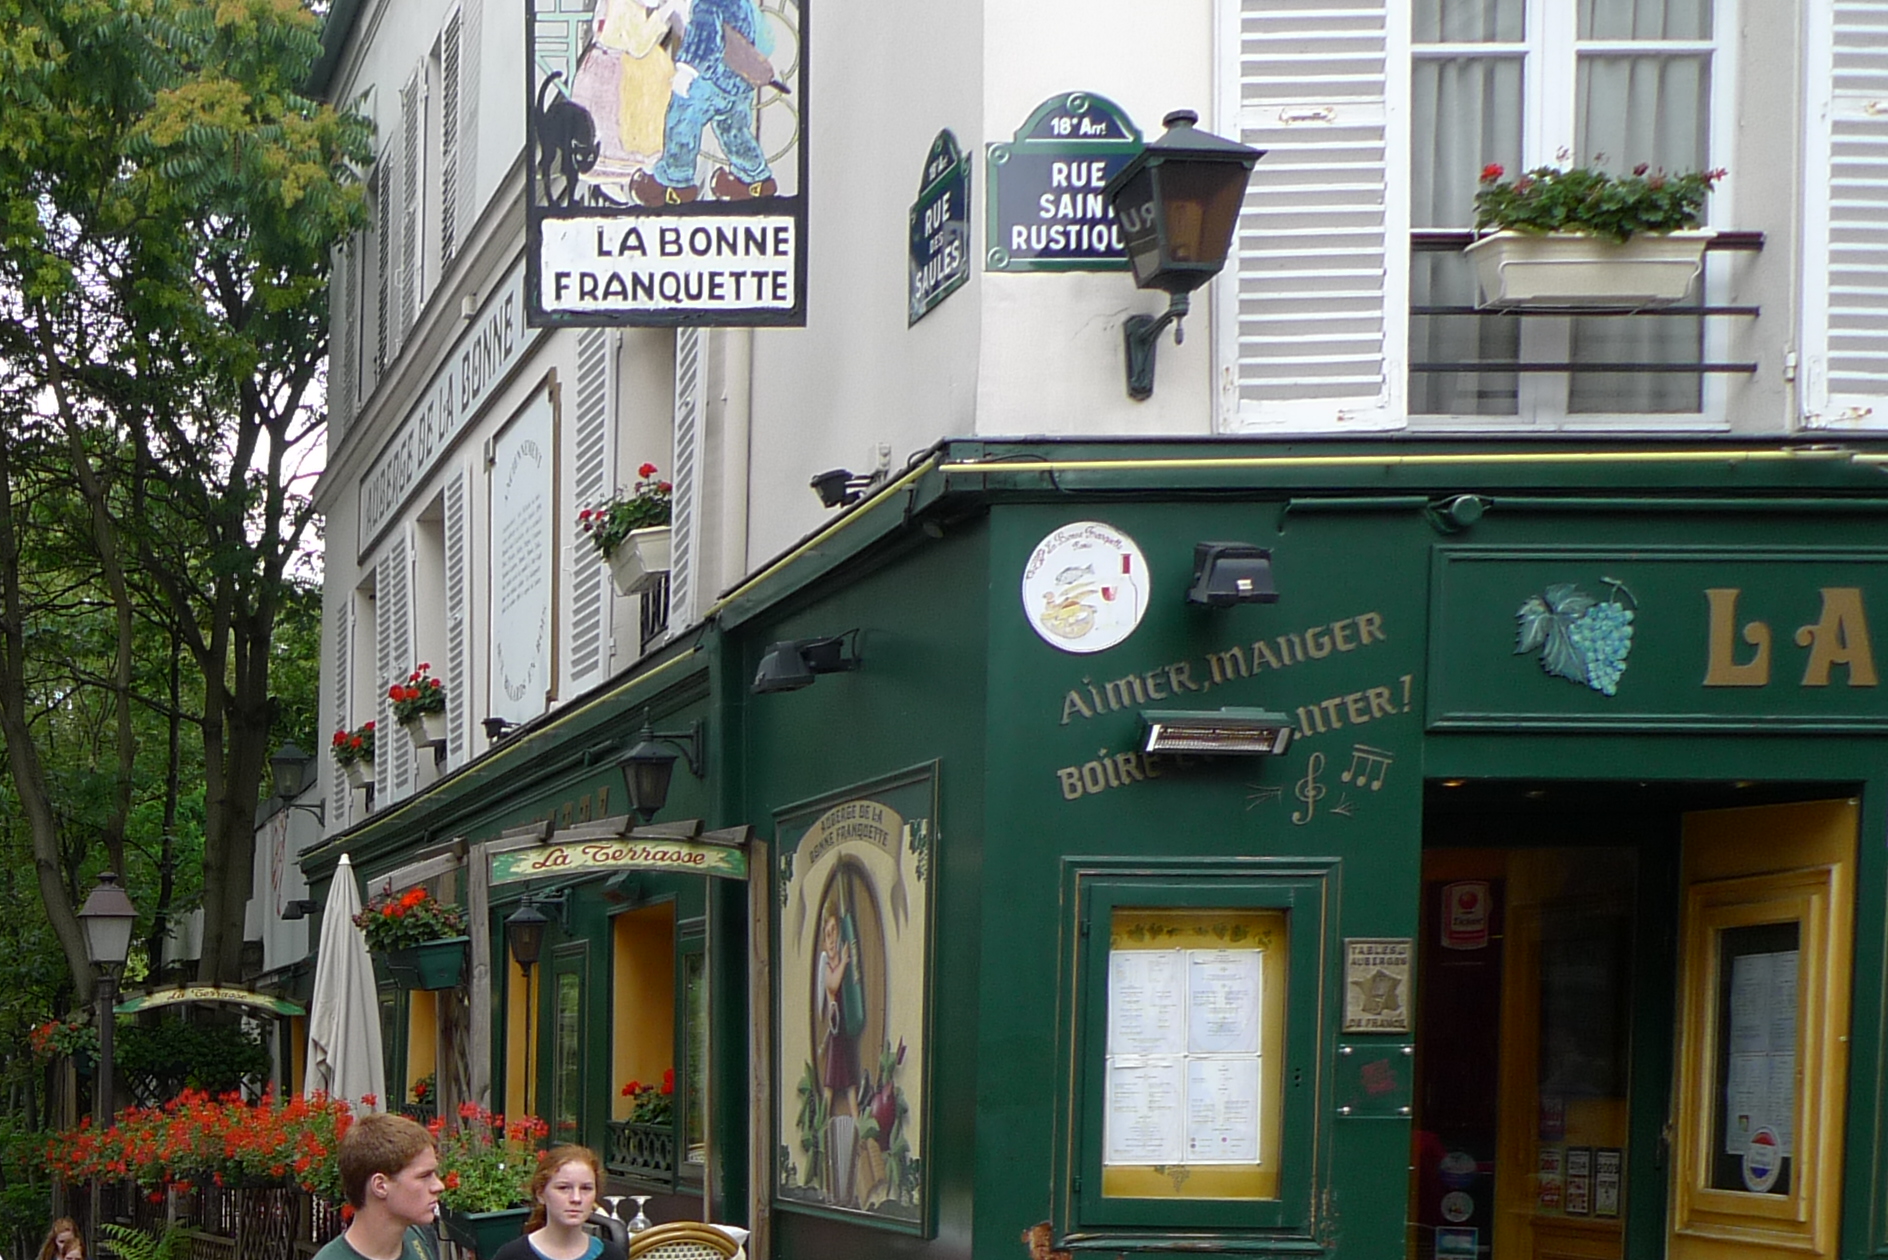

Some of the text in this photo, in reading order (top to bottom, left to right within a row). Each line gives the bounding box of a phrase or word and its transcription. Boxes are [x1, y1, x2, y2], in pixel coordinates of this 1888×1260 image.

[1052, 162, 1106, 187] RUE
[924, 192, 951, 239] RUE
[1039, 194, 1114, 219] SAIN
[597, 226, 789, 257] LA BONNE
[929, 227, 944, 255] DES
[1012, 225, 1126, 251] RUSTIQU
[916, 240, 960, 299] SAULES
[554, 271, 788, 303] FRANQUETTE
[365, 290, 514, 536] AUBERGE DE LA BONNE
[1702, 587, 1879, 687] LA
[858, 804, 871, 820] DE
[836, 822, 890, 848] FRANQUETTE
[532, 844, 706, 869] La Terrasse
[1350, 957, 1408, 966] AUBERGES
[1366, 1018, 1406, 1029] FRANCE
